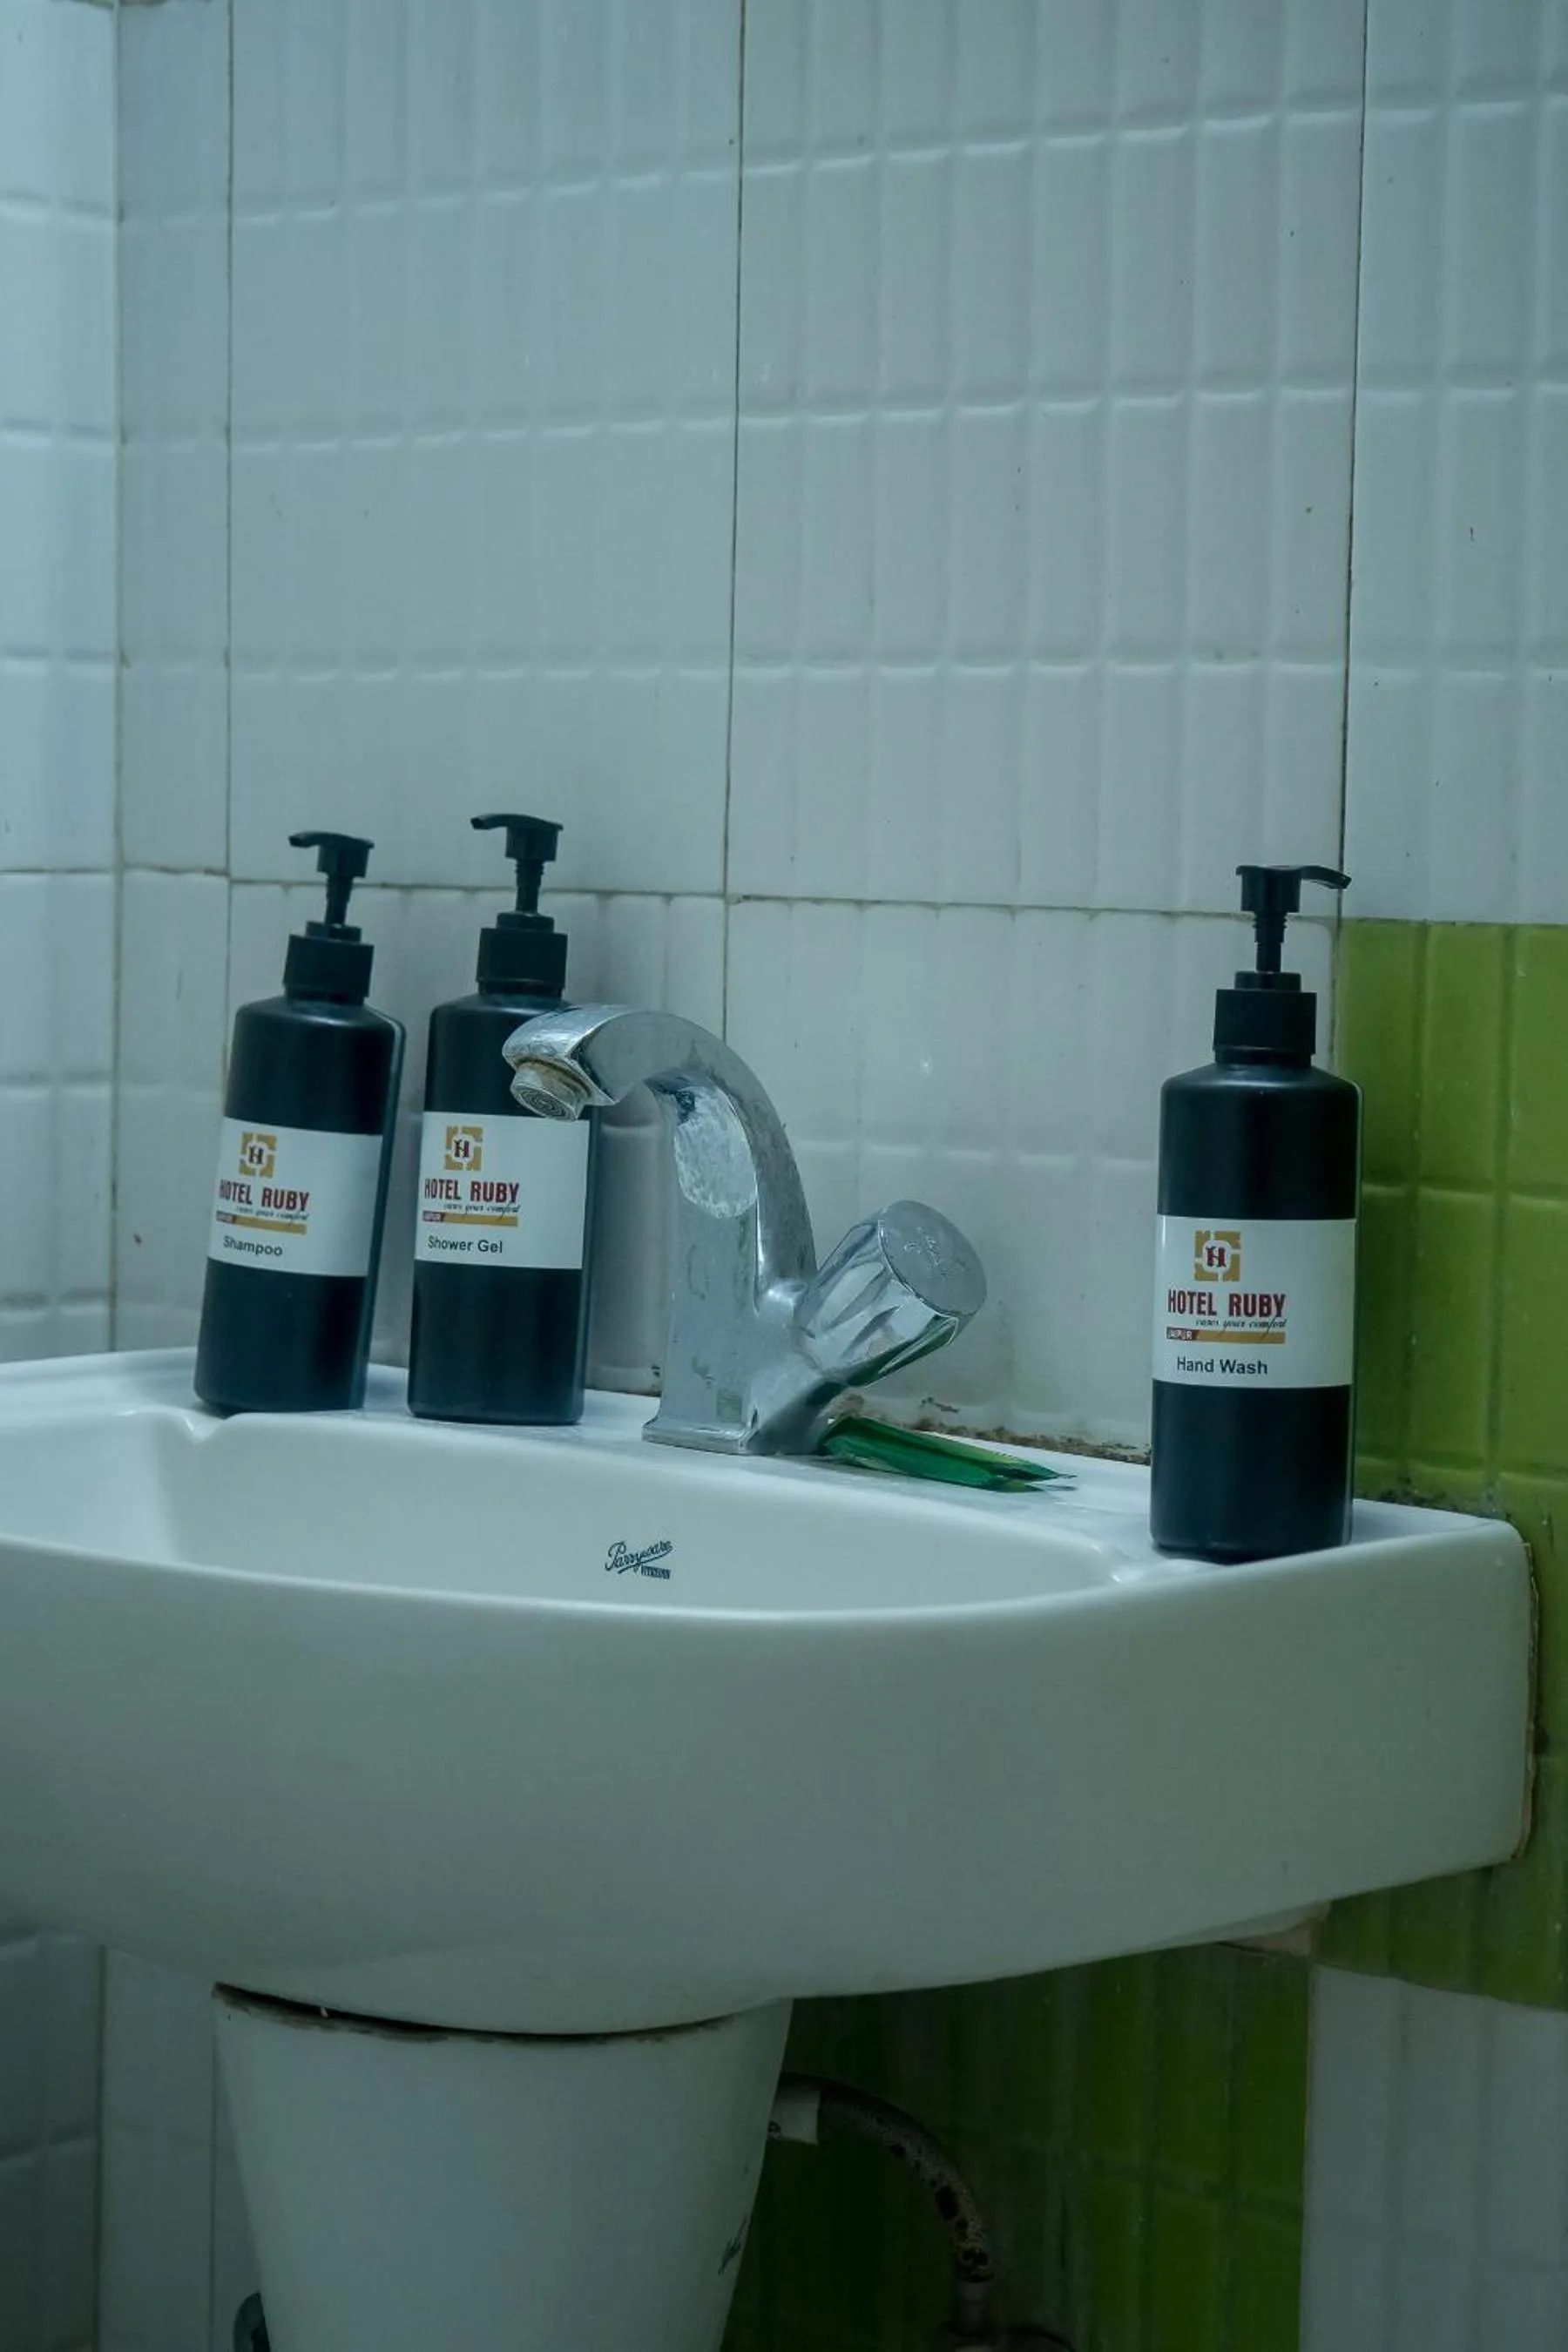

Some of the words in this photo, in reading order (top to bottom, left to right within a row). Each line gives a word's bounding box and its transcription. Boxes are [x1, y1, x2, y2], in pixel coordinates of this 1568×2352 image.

[219, 1178, 253, 1205] HOTEL
[261, 1186, 310, 1212] RUBY
[424, 1178, 462, 1201] HOTEL
[470, 1180, 520, 1204] RUBY
[222, 1234, 283, 1257] Shampoo
[428, 1235, 473, 1252] Shower
[477, 1239, 504, 1254] Gel
[1167, 1288, 1218, 1317] HOTEL
[1228, 1293, 1287, 1318] RUBY
[1176, 1355, 1214, 1373] Hand
[1220, 1358, 1268, 1375] Wash
